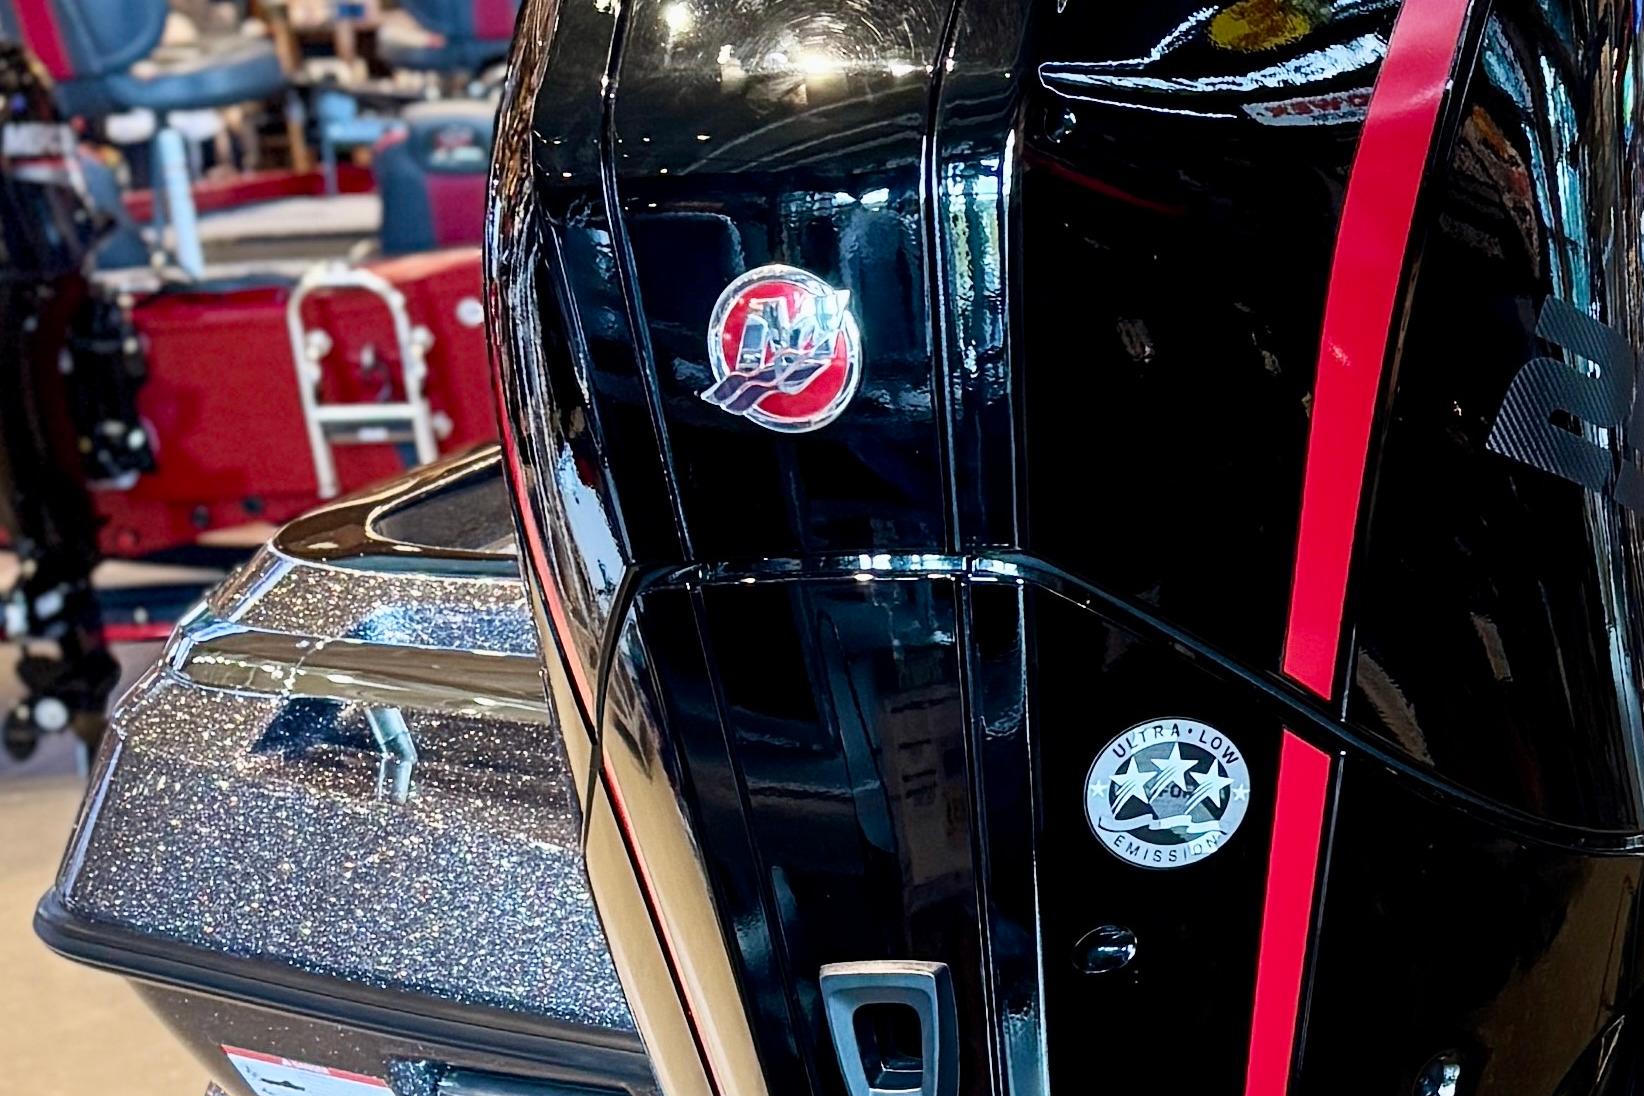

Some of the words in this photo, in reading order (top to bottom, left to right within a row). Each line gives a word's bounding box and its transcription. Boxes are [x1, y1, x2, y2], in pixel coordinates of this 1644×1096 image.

[1112, 722, 1181, 759] ULTRA
[1198, 729, 1240, 765] LOW
[1113, 834, 1220, 863] EMISSION
